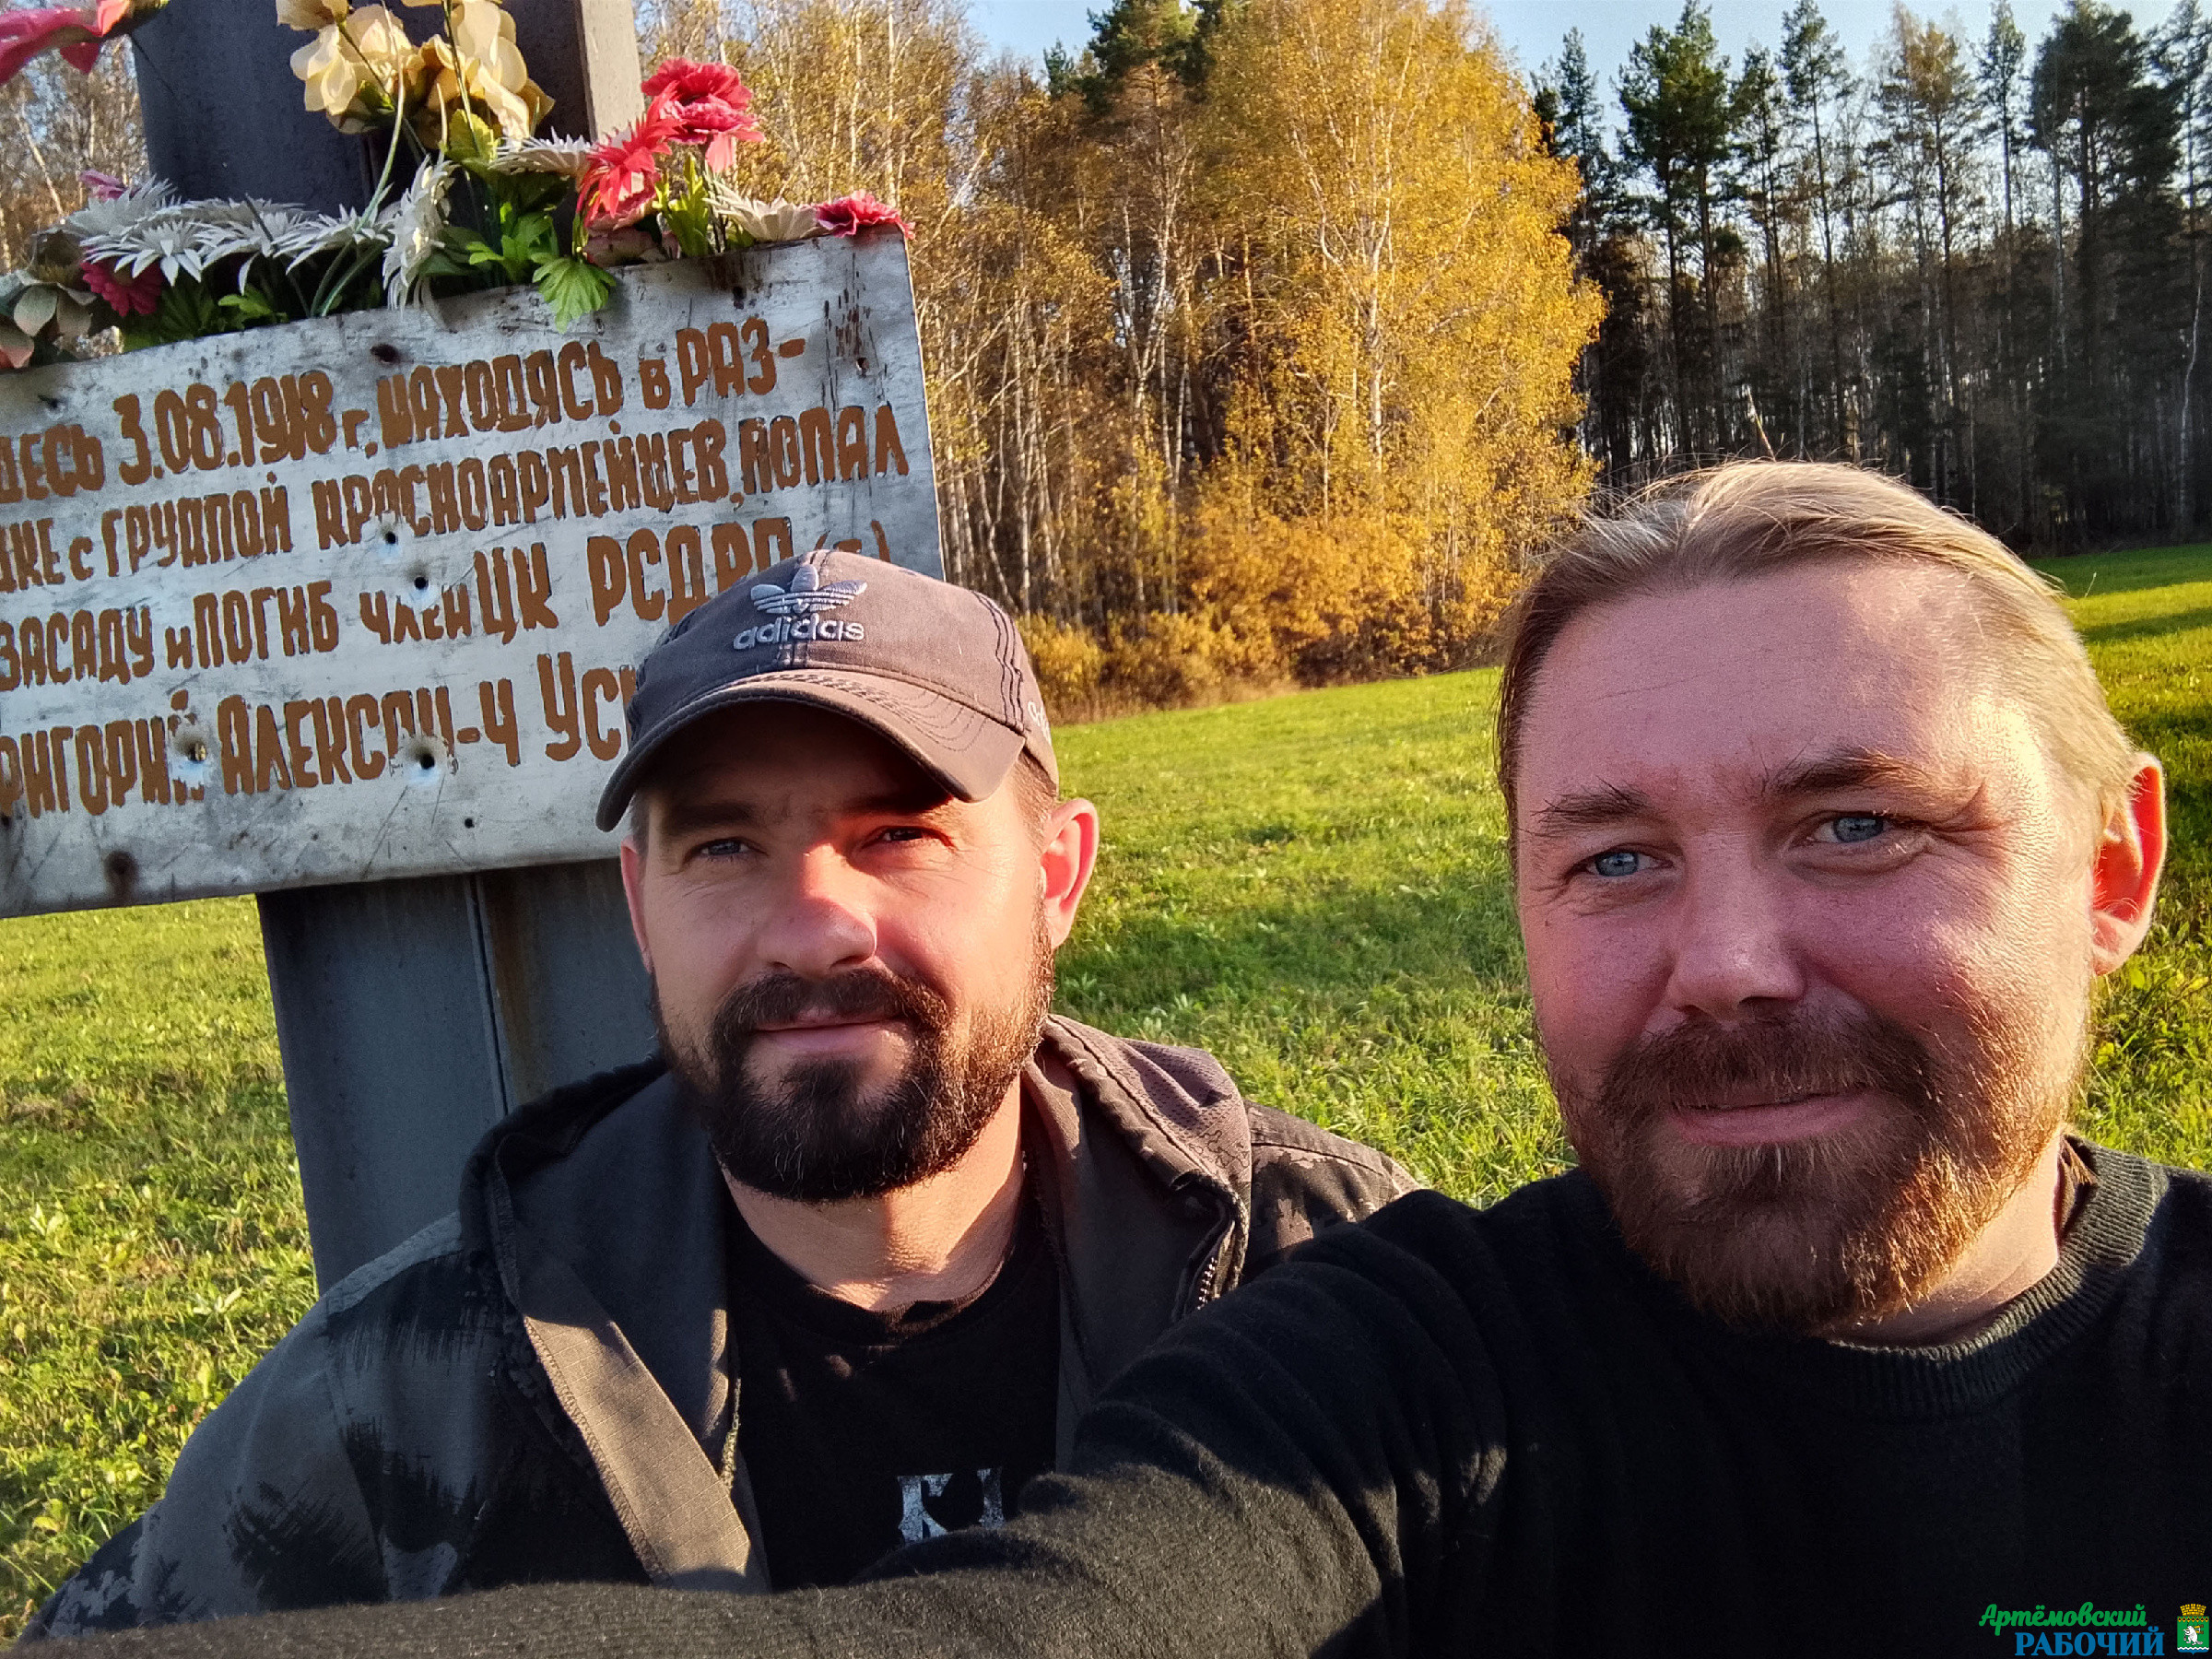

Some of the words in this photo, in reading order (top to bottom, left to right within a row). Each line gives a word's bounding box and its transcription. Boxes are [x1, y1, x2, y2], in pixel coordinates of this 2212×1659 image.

[100, 471, 293, 578] ГРУППОЙ
[192, 579, 340, 669] ПОГИБ
[473, 542, 559, 645] ЦК
[733, 612, 865, 651] adidas
